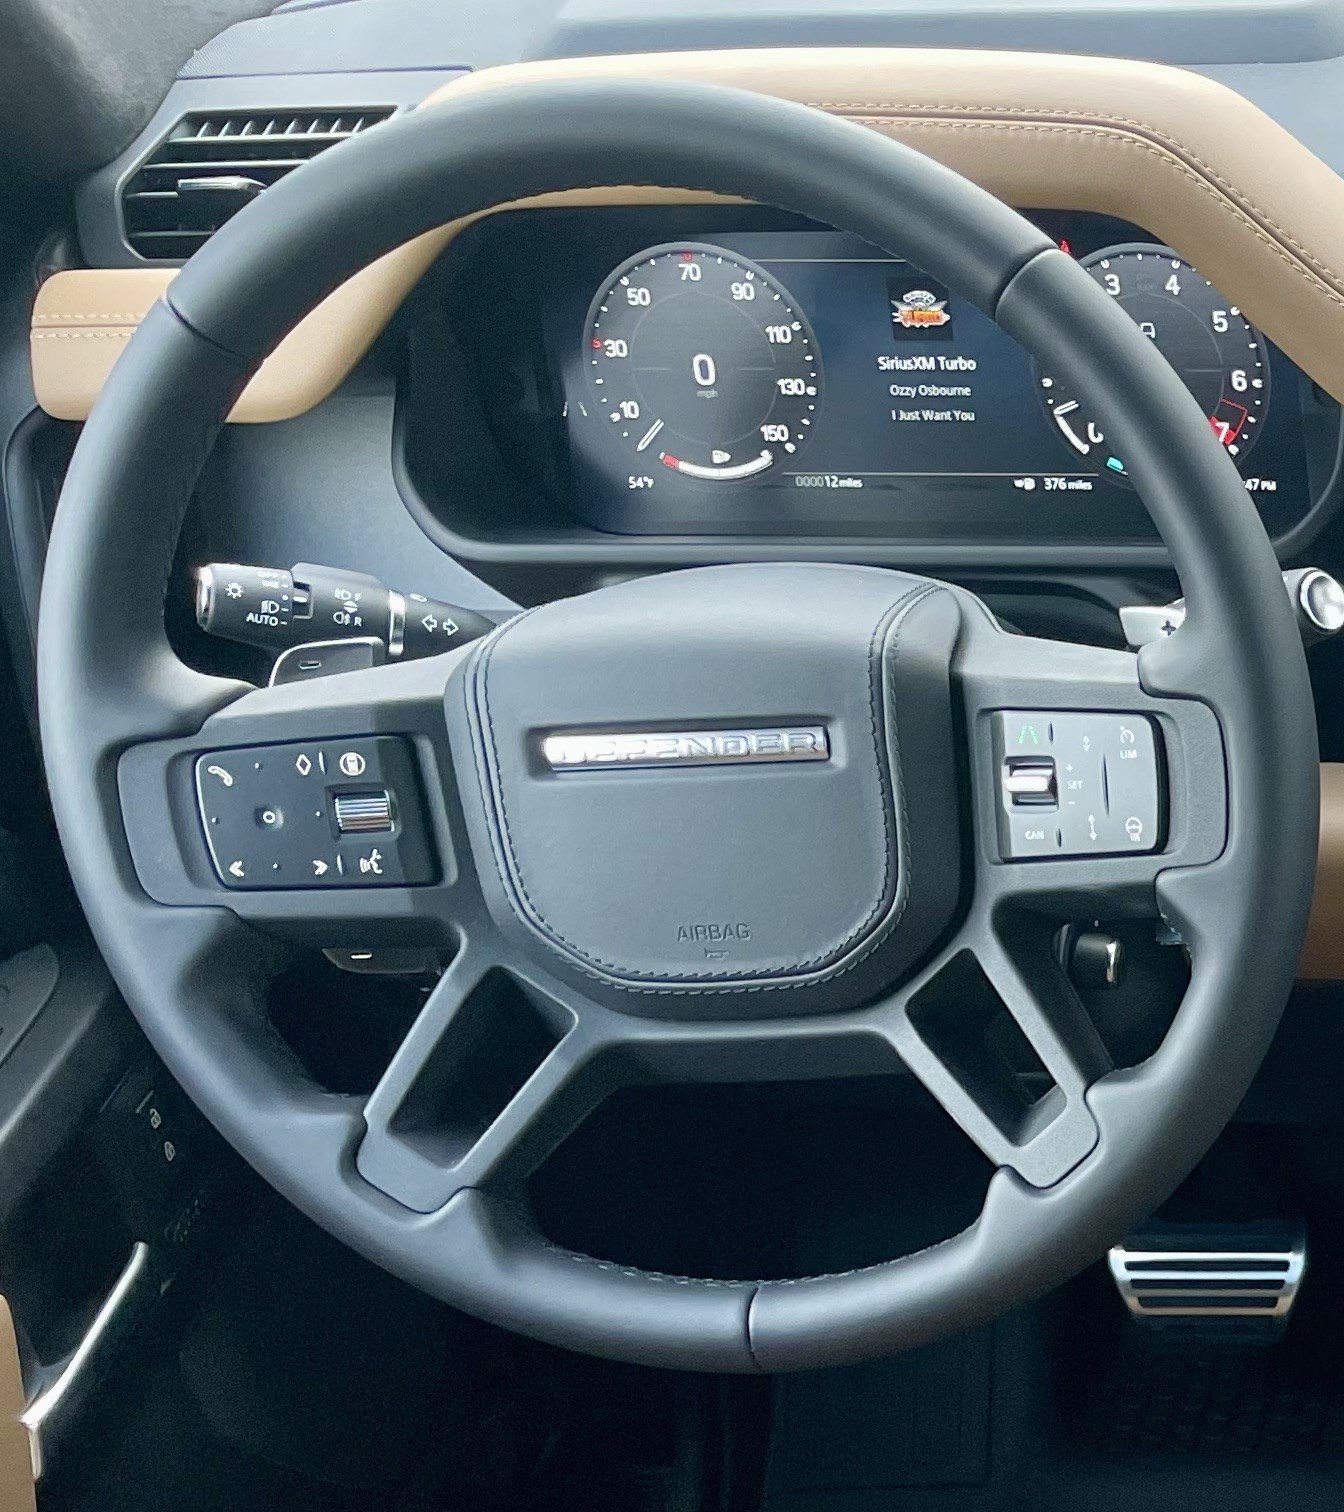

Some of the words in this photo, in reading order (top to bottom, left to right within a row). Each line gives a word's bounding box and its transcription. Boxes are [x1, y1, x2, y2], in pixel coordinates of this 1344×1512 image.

[678, 263, 701, 281] 70
[731, 283, 755, 301] 90
[1105, 273, 1121, 296] 3
[1165, 274, 1181, 296] 4
[626, 288, 651, 306] 50
[1212, 310, 1228, 333] 5
[765, 325, 792, 344] 110
[604, 340, 627, 358] 30
[692, 354, 716, 386] 0
[877, 356, 936, 371] SiriusXM
[938, 356, 977, 371] Turbo
[777, 378, 806, 397] 130
[1231, 370, 1247, 393] 6
[889, 384, 916, 398] Ozzy
[918, 384, 972, 397] Osbourne
[619, 401, 640, 419] 10
[899, 409, 919, 422] Just
[921, 409, 951, 421] Want
[952, 409, 975, 422] You
[760, 424, 789, 442] 150
[1214, 422, 1230, 443] 7
[1044, 478, 1068, 491] 376
[1068, 479, 1092, 491] miles
[1261, 480, 1277, 491] PM
[246, 612, 279, 627] AUTO
[1067, 780, 1084, 790] SET
[1025, 830, 1045, 840] CAN
[676, 923, 750, 944] AIRBAG
